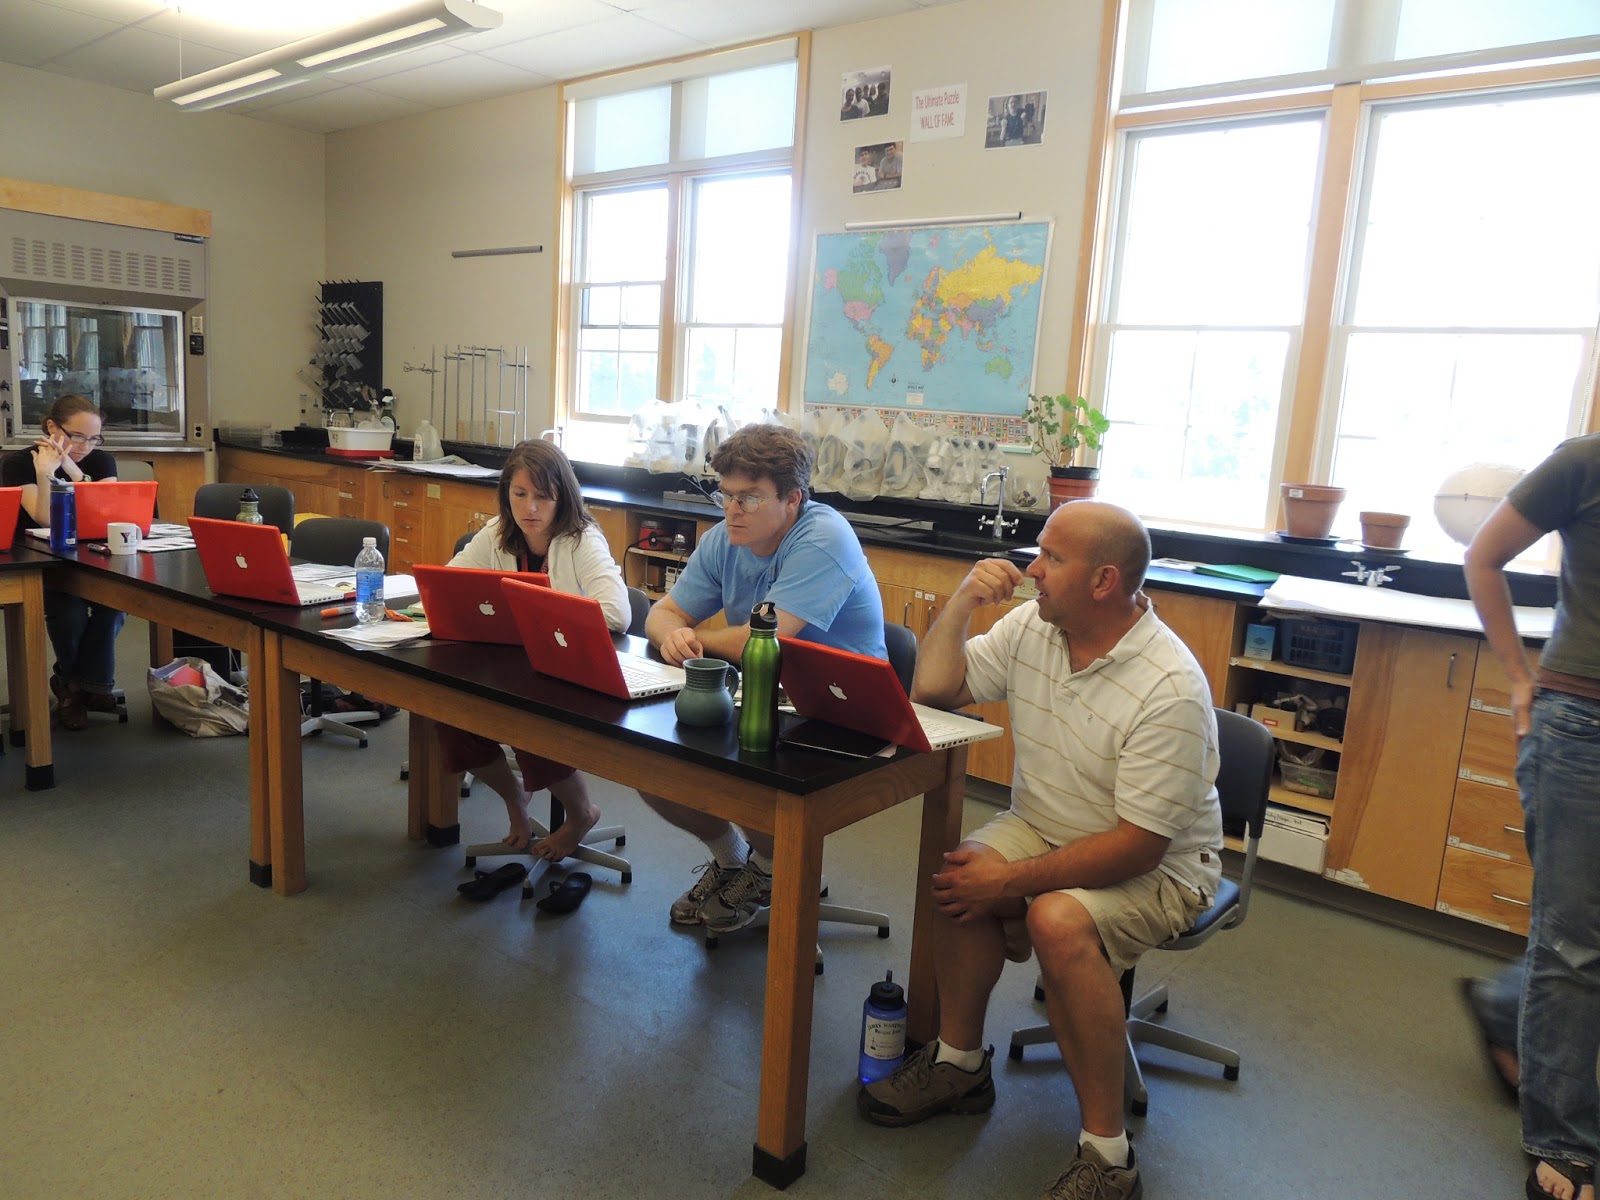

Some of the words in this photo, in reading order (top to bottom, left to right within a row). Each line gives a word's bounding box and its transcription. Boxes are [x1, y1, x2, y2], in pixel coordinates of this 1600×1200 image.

[915, 96, 924, 109] The
[924, 94, 943, 109] Ultimate
[943, 90, 960, 105] Puzzle
[920, 114, 934, 129] WALL
[934, 113, 941, 128] OF
[941, 112, 955, 127] FAME
